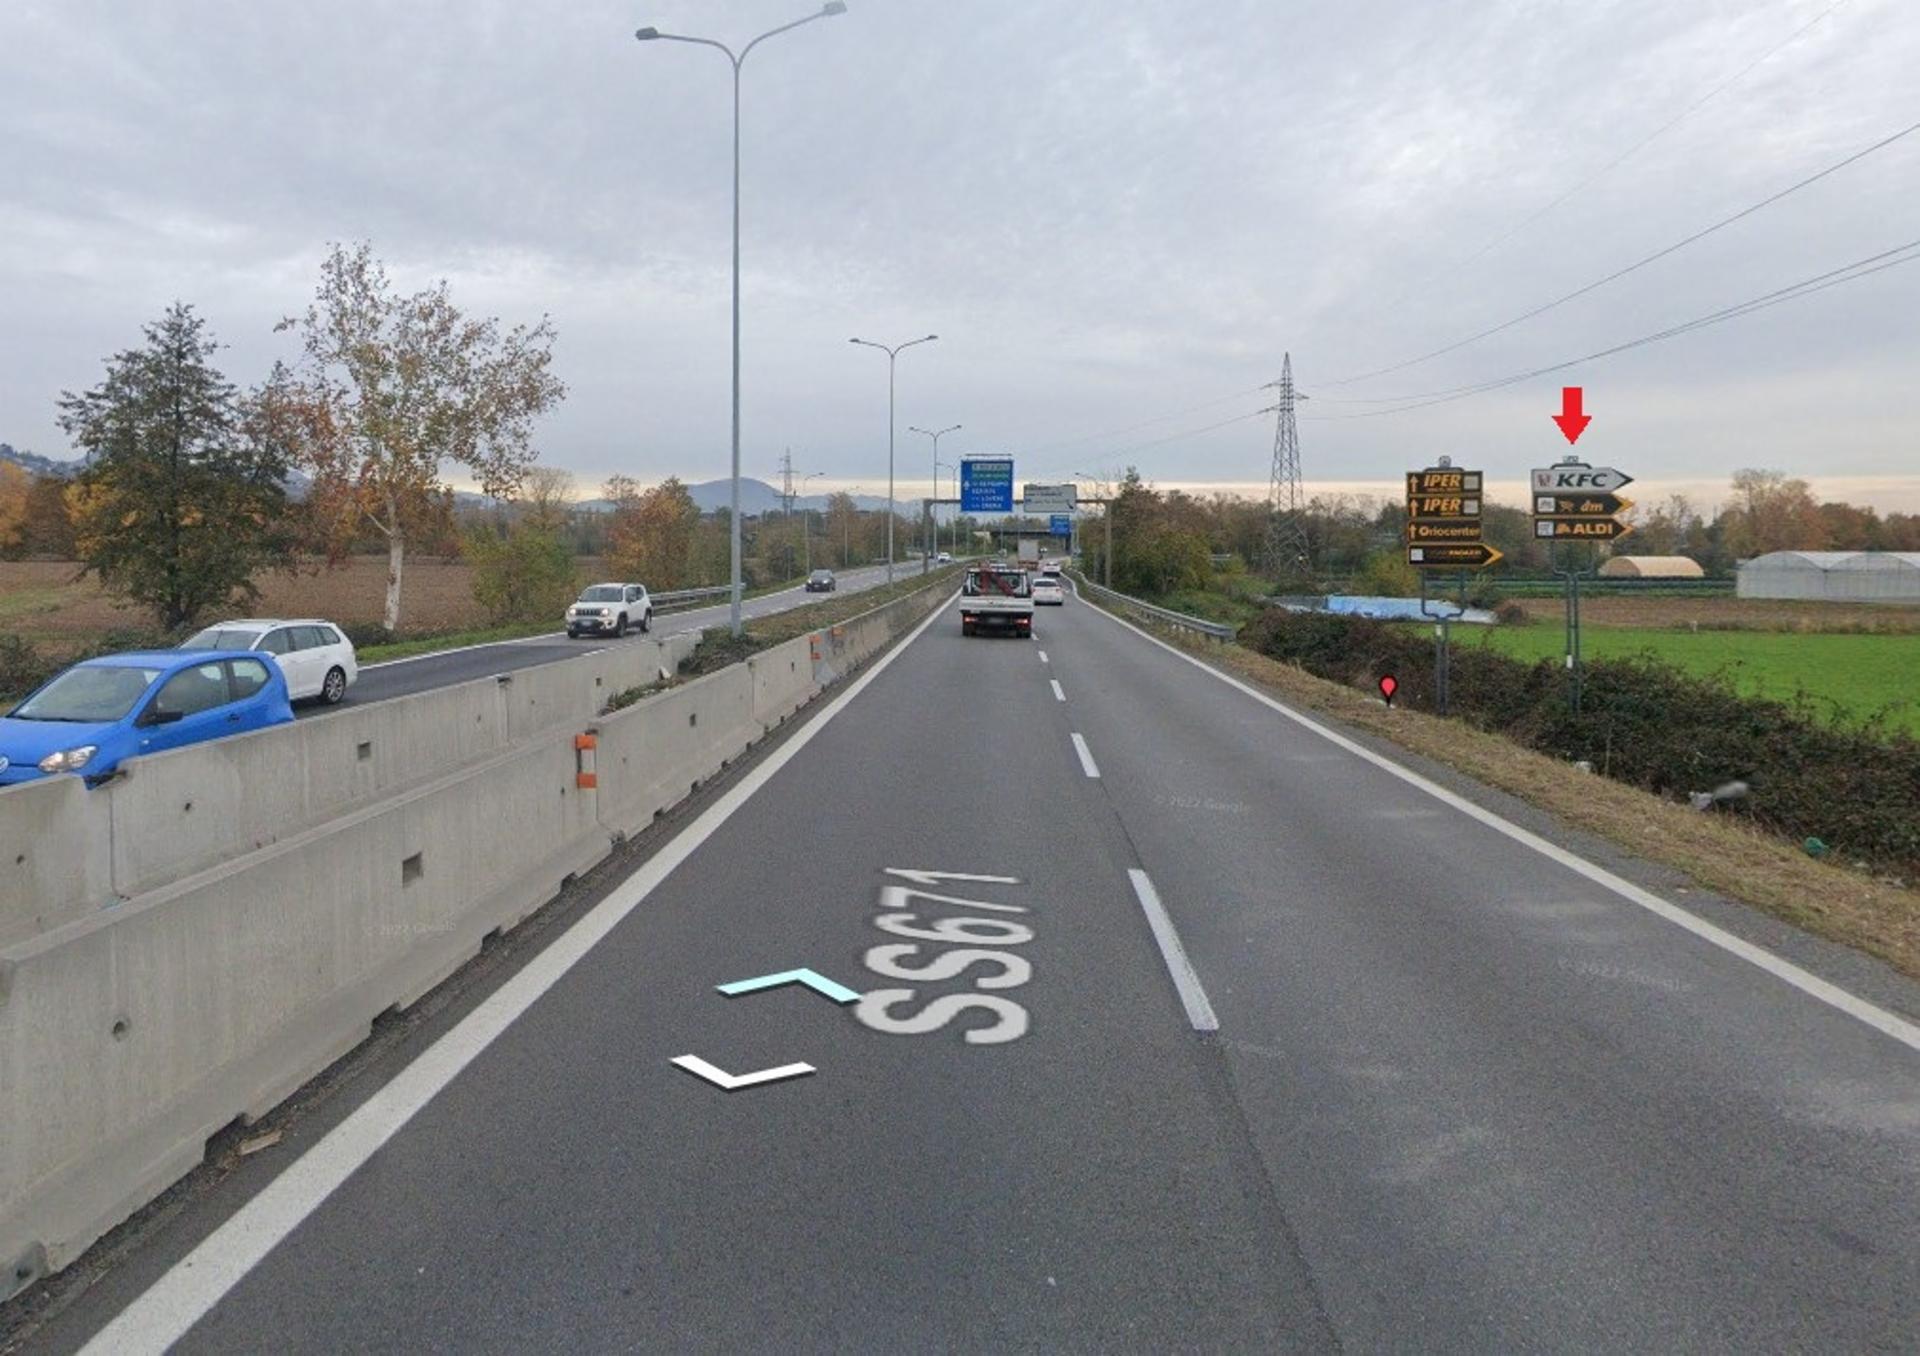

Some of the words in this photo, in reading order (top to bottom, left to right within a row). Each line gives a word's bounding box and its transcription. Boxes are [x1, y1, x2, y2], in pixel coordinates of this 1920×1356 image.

[1423, 474, 1462, 487] IPER
[1556, 473, 1608, 487] KFC
[1423, 498, 1462, 512] IPER
[1580, 500, 1604, 512] dm
[1419, 526, 1481, 536] Oriocenter
[1573, 523, 1613, 534] ALDI
